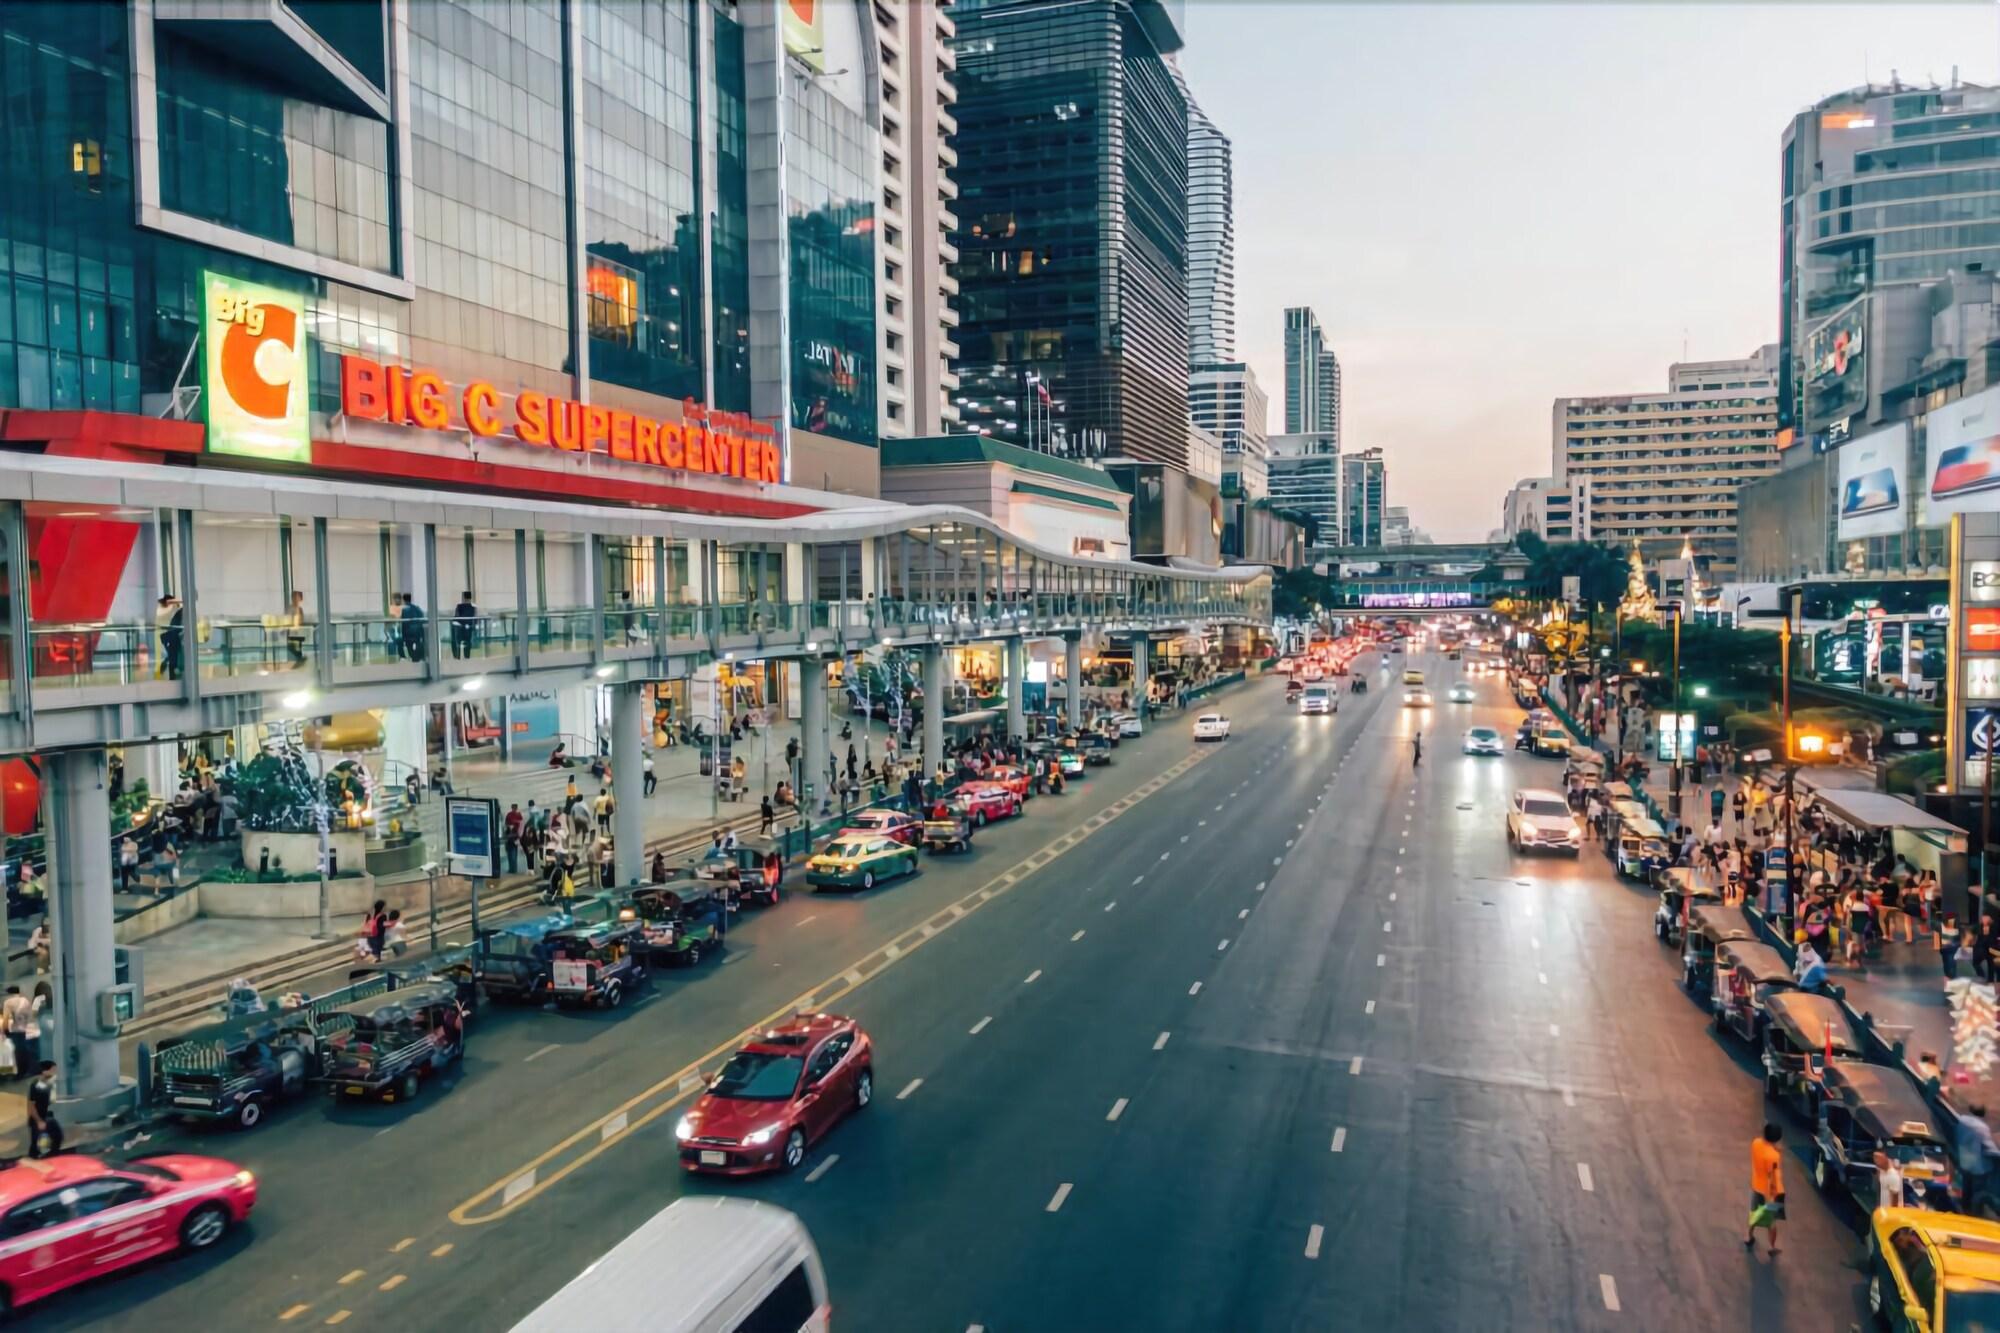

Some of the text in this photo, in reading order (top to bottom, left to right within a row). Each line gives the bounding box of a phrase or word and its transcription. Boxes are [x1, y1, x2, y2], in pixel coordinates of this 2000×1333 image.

[217, 293, 297, 419] Big C
[340, 355, 450, 431] BIG
[463, 381, 503, 437] C
[513, 389, 781, 484] SUPERCENTER
